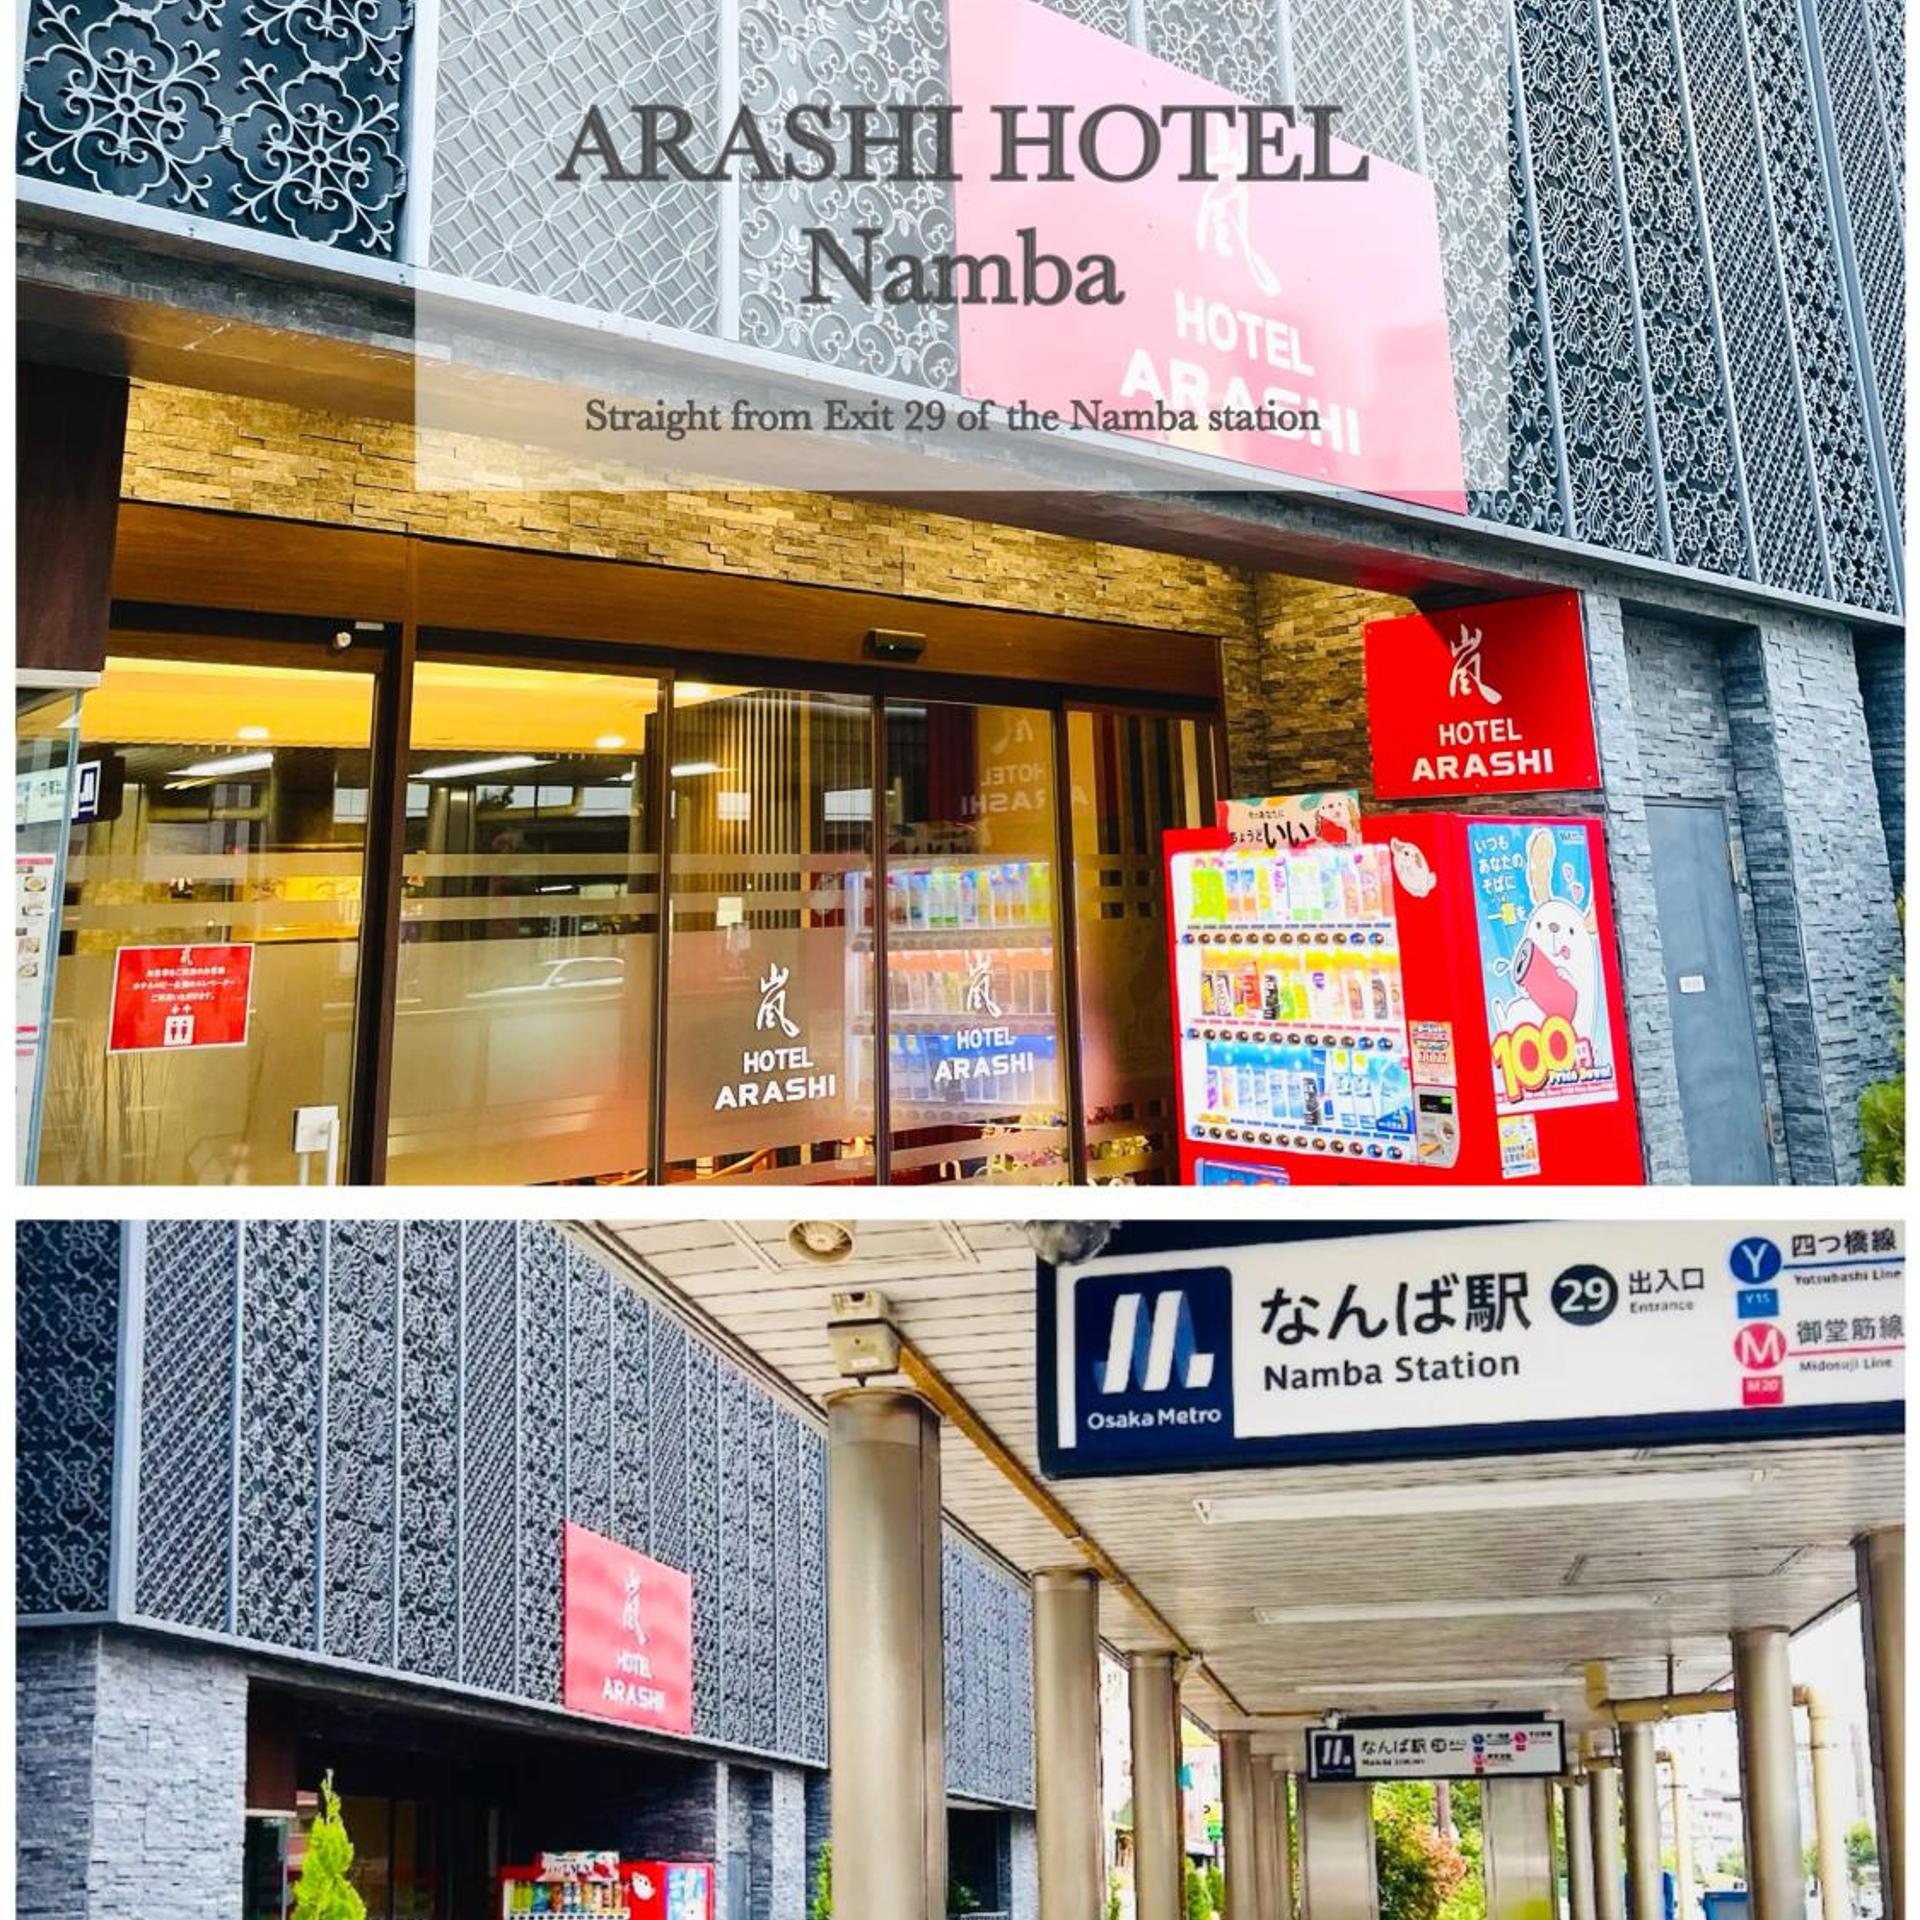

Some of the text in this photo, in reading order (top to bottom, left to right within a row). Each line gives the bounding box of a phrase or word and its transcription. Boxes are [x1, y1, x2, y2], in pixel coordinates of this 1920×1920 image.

[1175, 289, 1315, 376] HOTEL
[1120, 348, 1361, 456] ARASHI
[1439, 718, 1522, 746] HOTEL
[1411, 748, 1554, 781] ARASHI
[1474, 835, 1509, 853] いつも
[1478, 853, 1523, 874] あなたの
[956, 1026, 1015, 1050] HOTEL
[743, 1046, 814, 1074] HOTEL
[934, 1052, 1034, 1083] ARASHI
[714, 1074, 836, 1110] ARASHI
[1792, 1227, 1897, 1257] 四つ橋線
[1741, 1243, 1768, 1278] Y
[1628, 1267, 1706, 1296] 出入口
[1794, 1269, 1902, 1286] Yotsubashi Line
[1260, 1271, 1532, 1346] なんば駅
[1558, 1276, 1611, 1314] 29
[1630, 1300, 1694, 1314] Entrance
[1797, 1314, 1905, 1345] 御堂筋線
[1741, 1329, 1781, 1366] M
[1264, 1350, 1520, 1392] Namba Station
[1799, 1357, 1893, 1374] Midosuji Line
[1087, 1407, 1222, 1430] Osaka Metro
[602, 1677, 665, 1712] ARASHI
[1362, 1737, 1427, 1755] なんば駅
